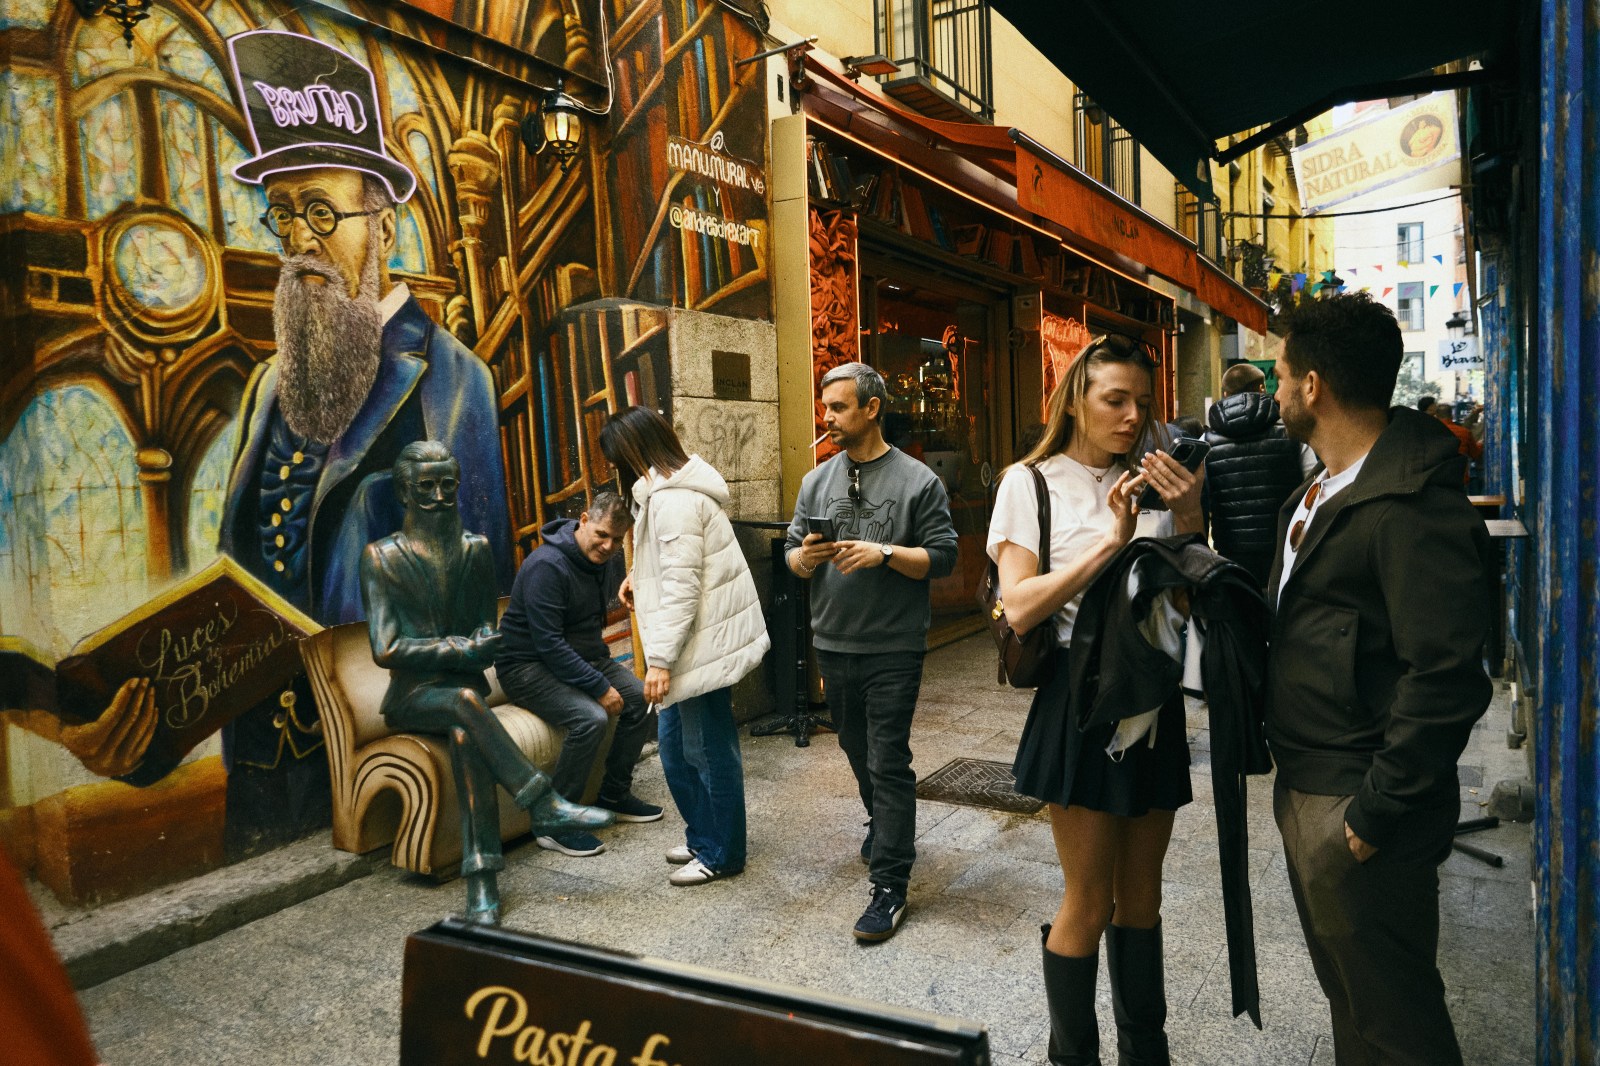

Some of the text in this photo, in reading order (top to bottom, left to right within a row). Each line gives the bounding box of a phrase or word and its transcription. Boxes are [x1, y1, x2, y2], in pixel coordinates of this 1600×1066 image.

[710, 130, 724, 154] @
[1302, 141, 1364, 179] SIDRA
[1305, 151, 1398, 199] NATURAL
[136, 600, 238, 681] Luces
[167, 611, 284, 729] Bohemia
[465, 986, 618, 1066] Pasta
